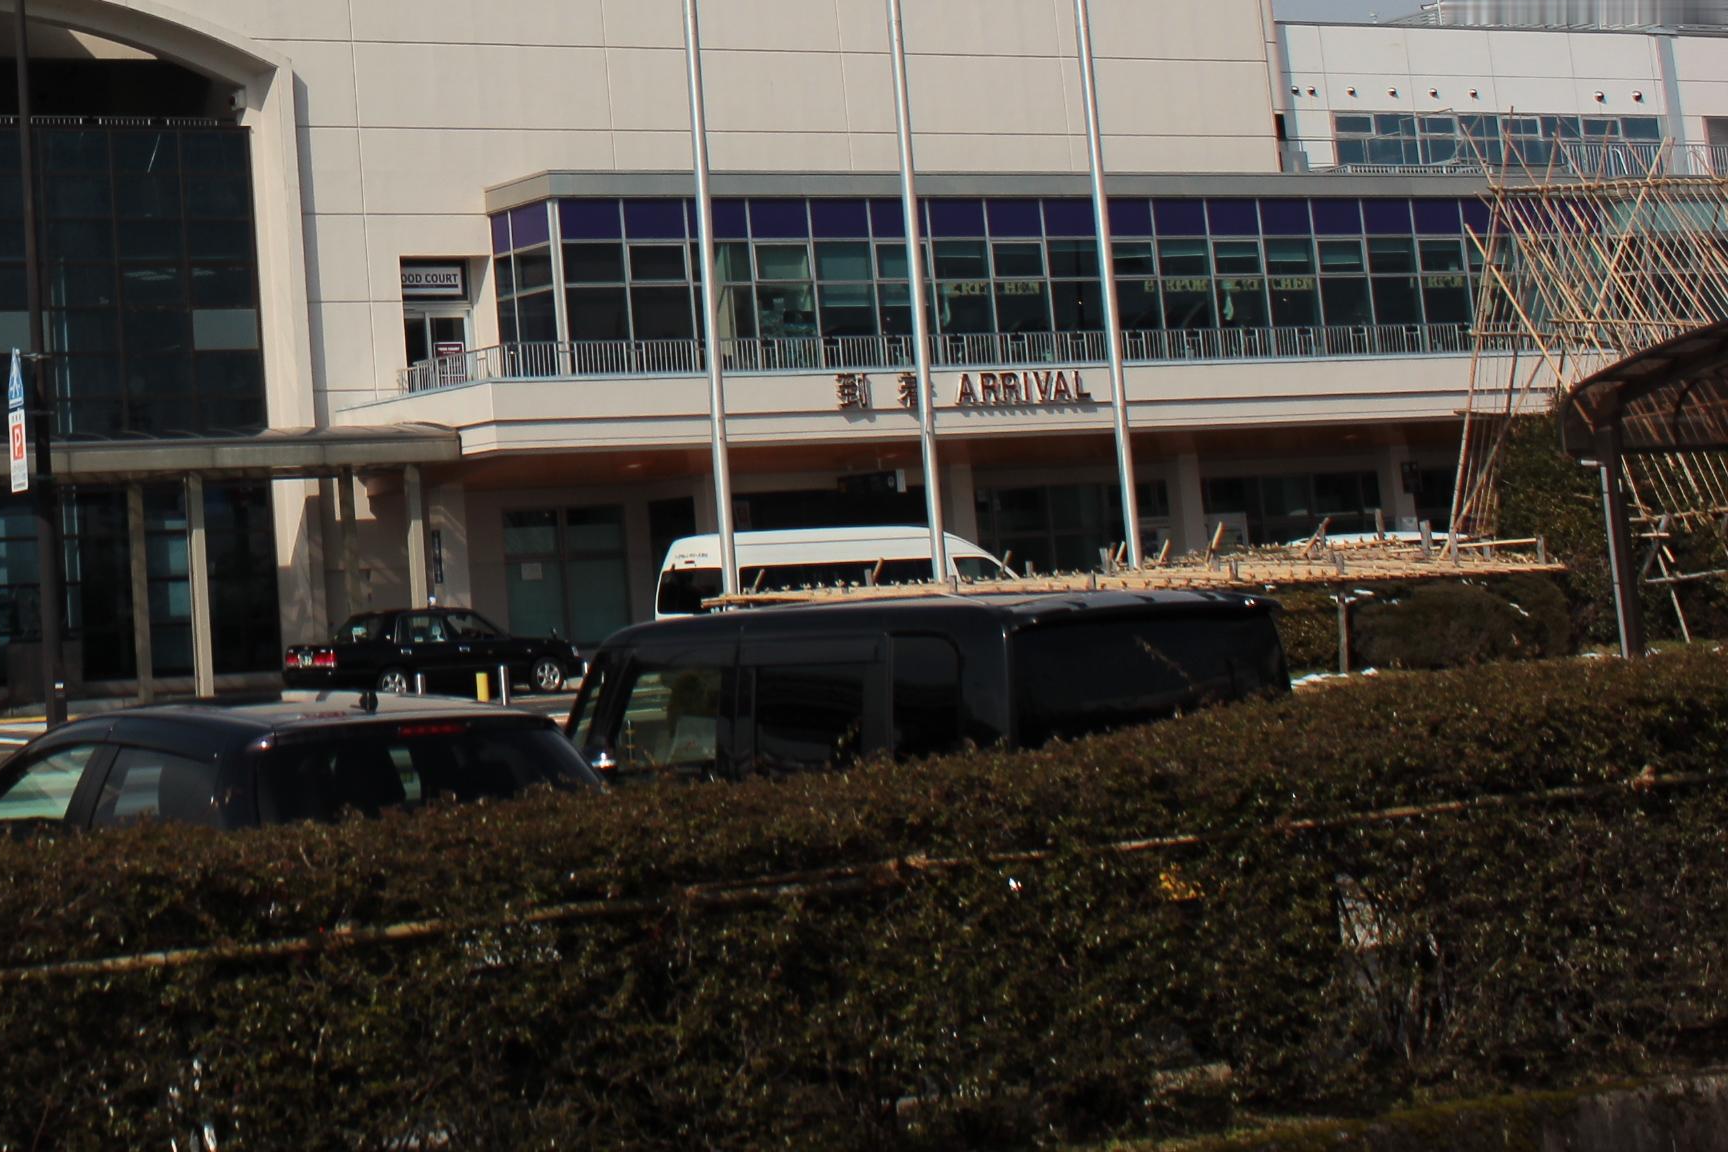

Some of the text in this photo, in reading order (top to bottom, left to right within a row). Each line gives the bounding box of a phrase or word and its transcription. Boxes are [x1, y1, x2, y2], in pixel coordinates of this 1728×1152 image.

[401, 273, 458, 284] OOD COURT
[956, 370, 1091, 404] ARRIVAL
